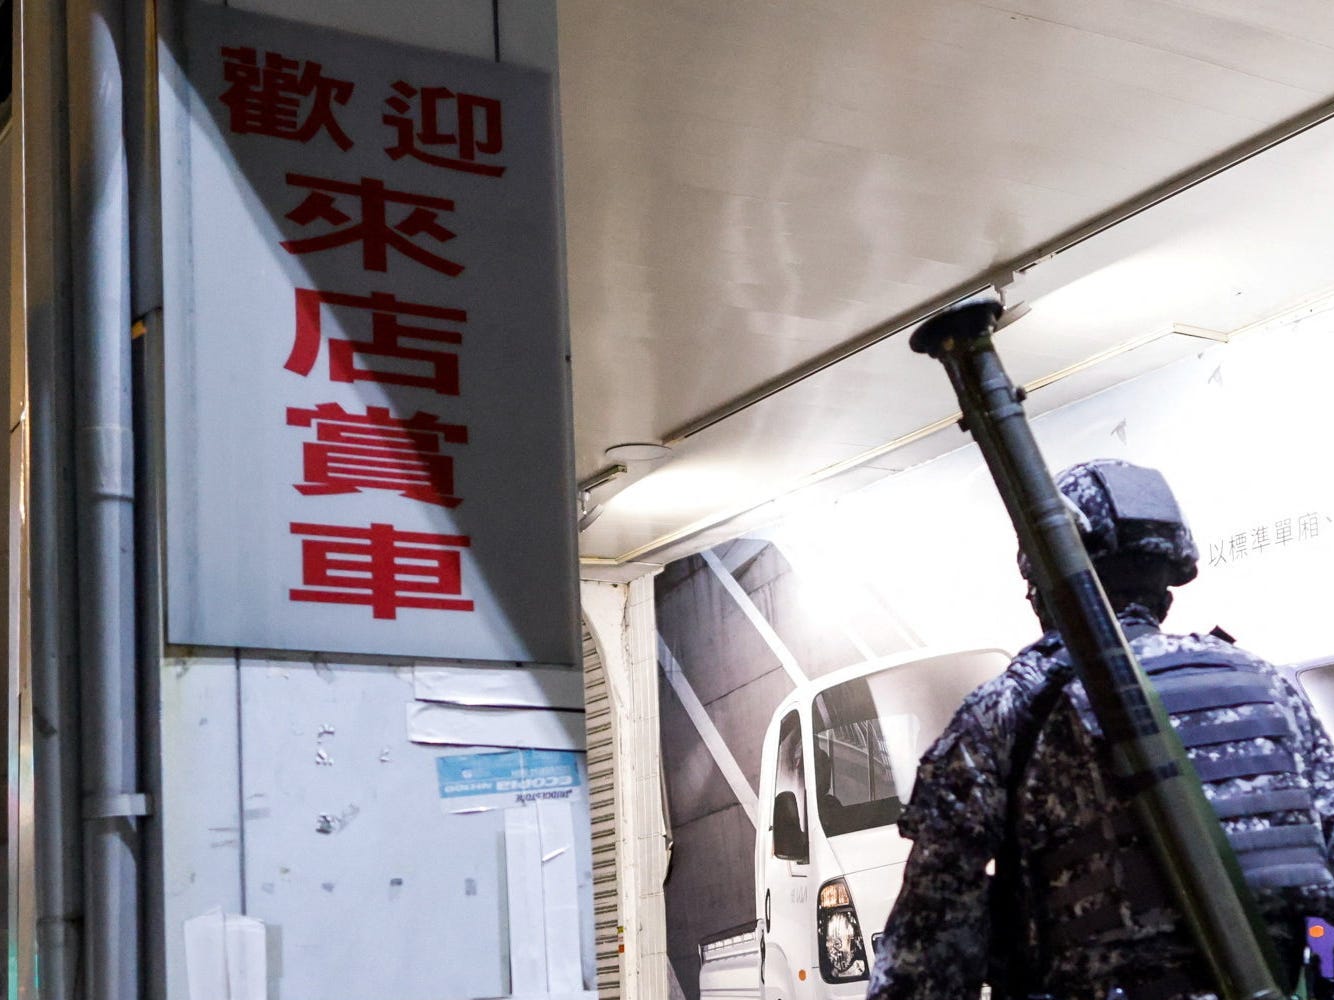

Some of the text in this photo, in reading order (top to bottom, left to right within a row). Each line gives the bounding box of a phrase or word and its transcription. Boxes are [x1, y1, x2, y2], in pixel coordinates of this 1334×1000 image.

[218, 46, 507, 178] 歡迎
[278, 172, 475, 620] 來店賞車
